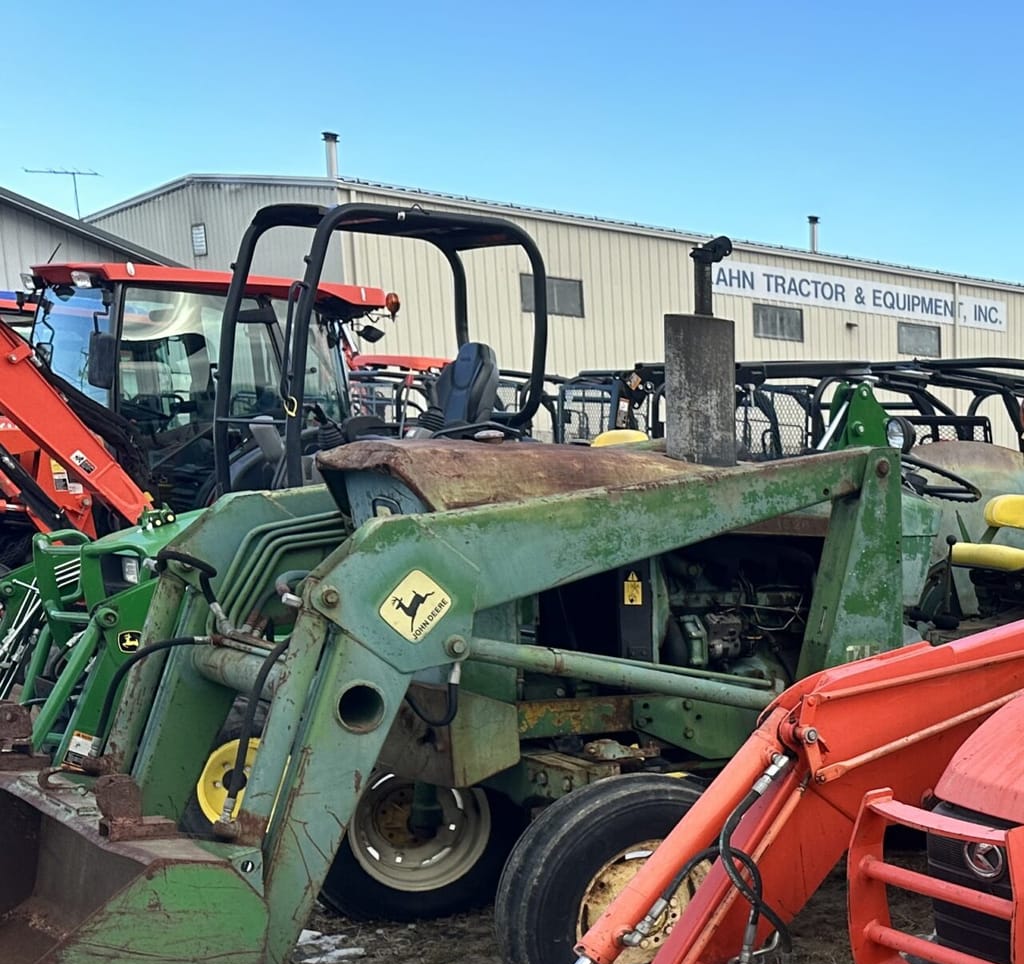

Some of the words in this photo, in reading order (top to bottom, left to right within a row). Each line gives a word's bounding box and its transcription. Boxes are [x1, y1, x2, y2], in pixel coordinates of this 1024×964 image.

[712, 266, 754, 290] AHN
[763, 273, 846, 303] TRACTOR
[854, 286, 865, 305] &
[974, 304, 1002, 325] INC.
[412, 620, 430, 640] JOHN
[427, 598, 448, 622] DEERE
